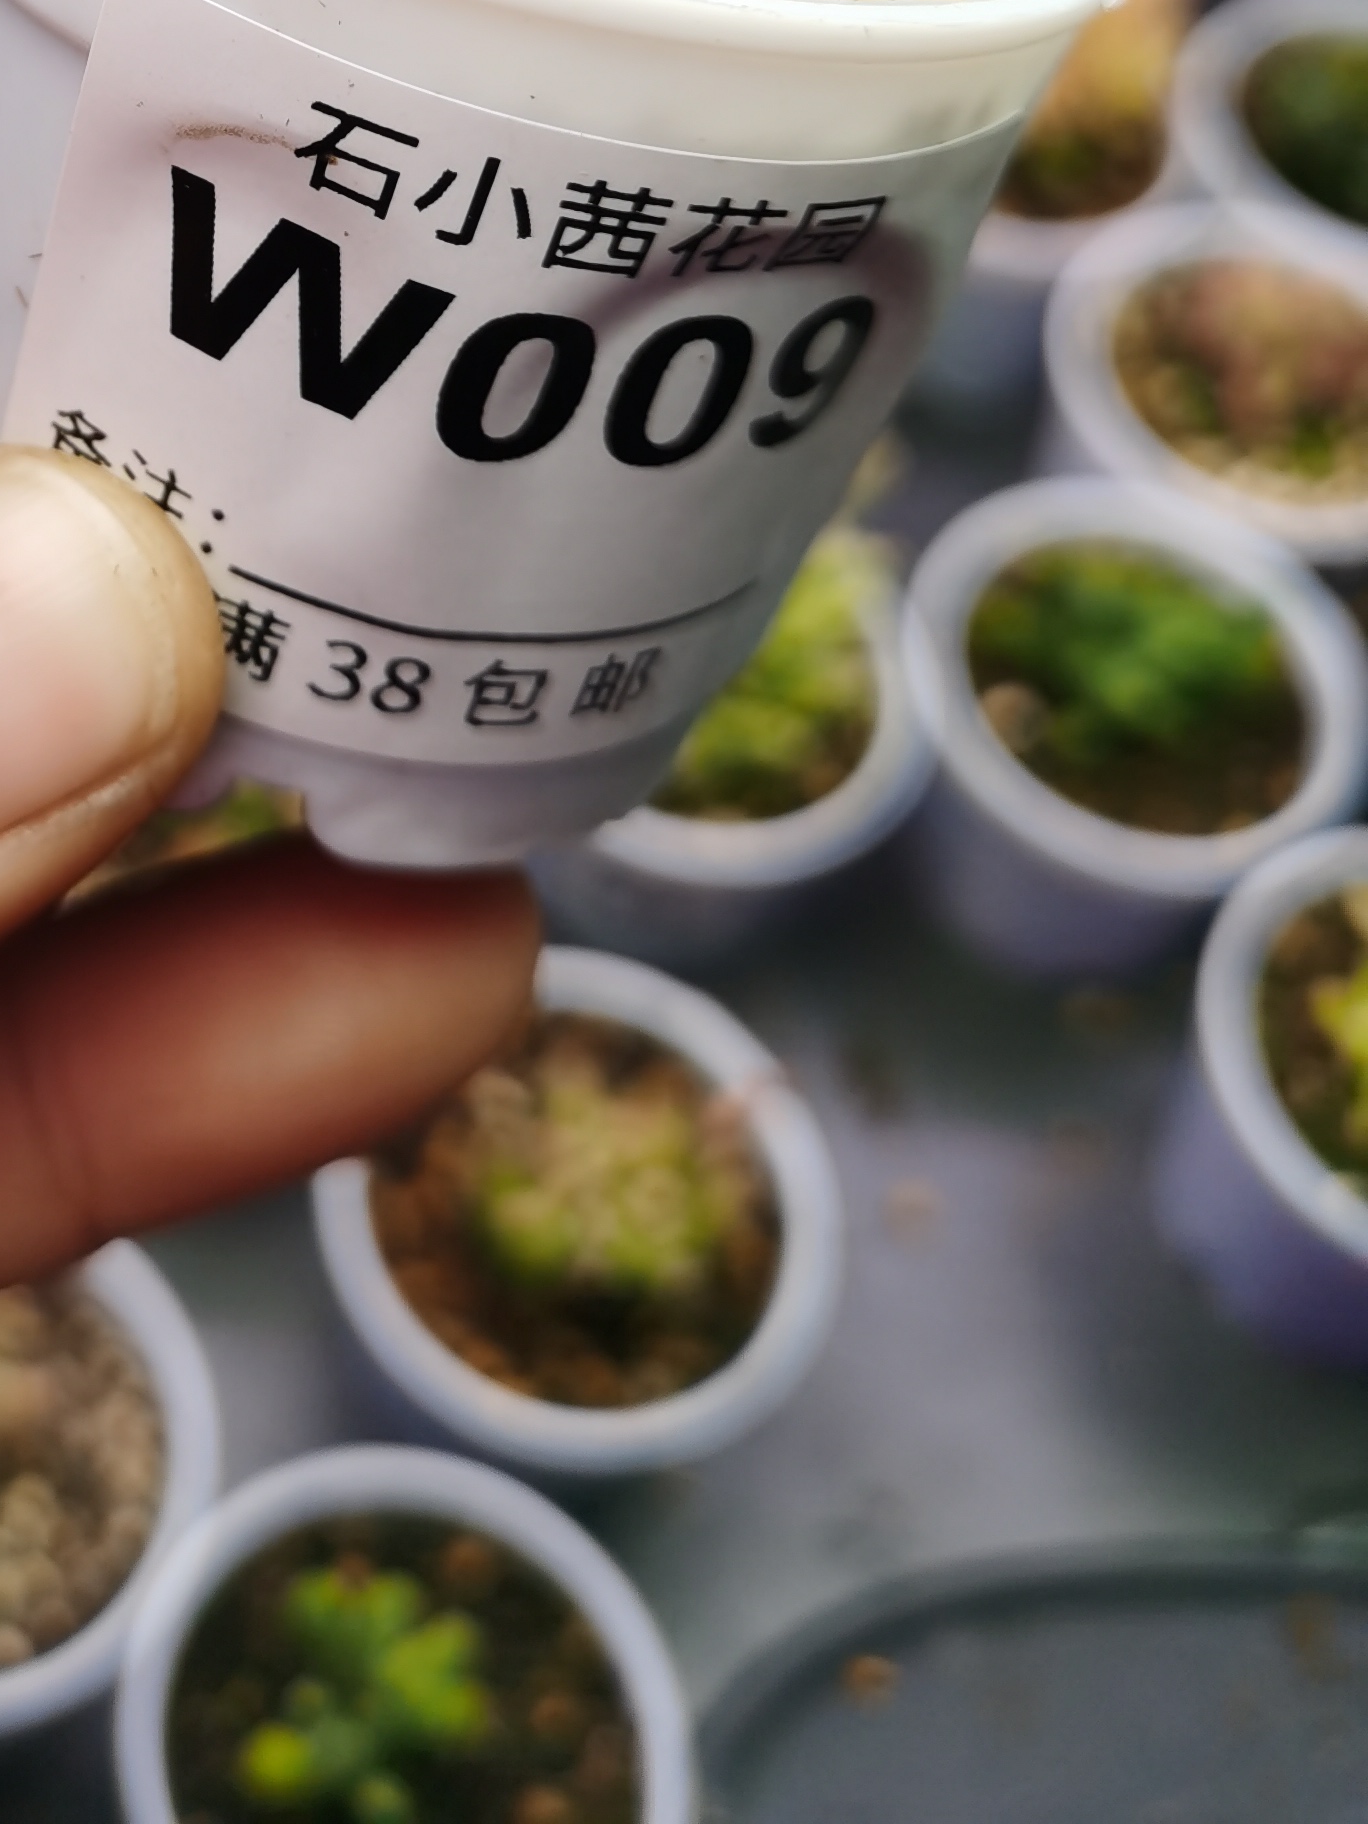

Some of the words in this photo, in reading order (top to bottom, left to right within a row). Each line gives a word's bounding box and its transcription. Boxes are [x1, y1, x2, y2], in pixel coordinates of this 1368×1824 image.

[294, 100, 888, 279] 石小茜花园
[170, 164, 875, 468] W009
